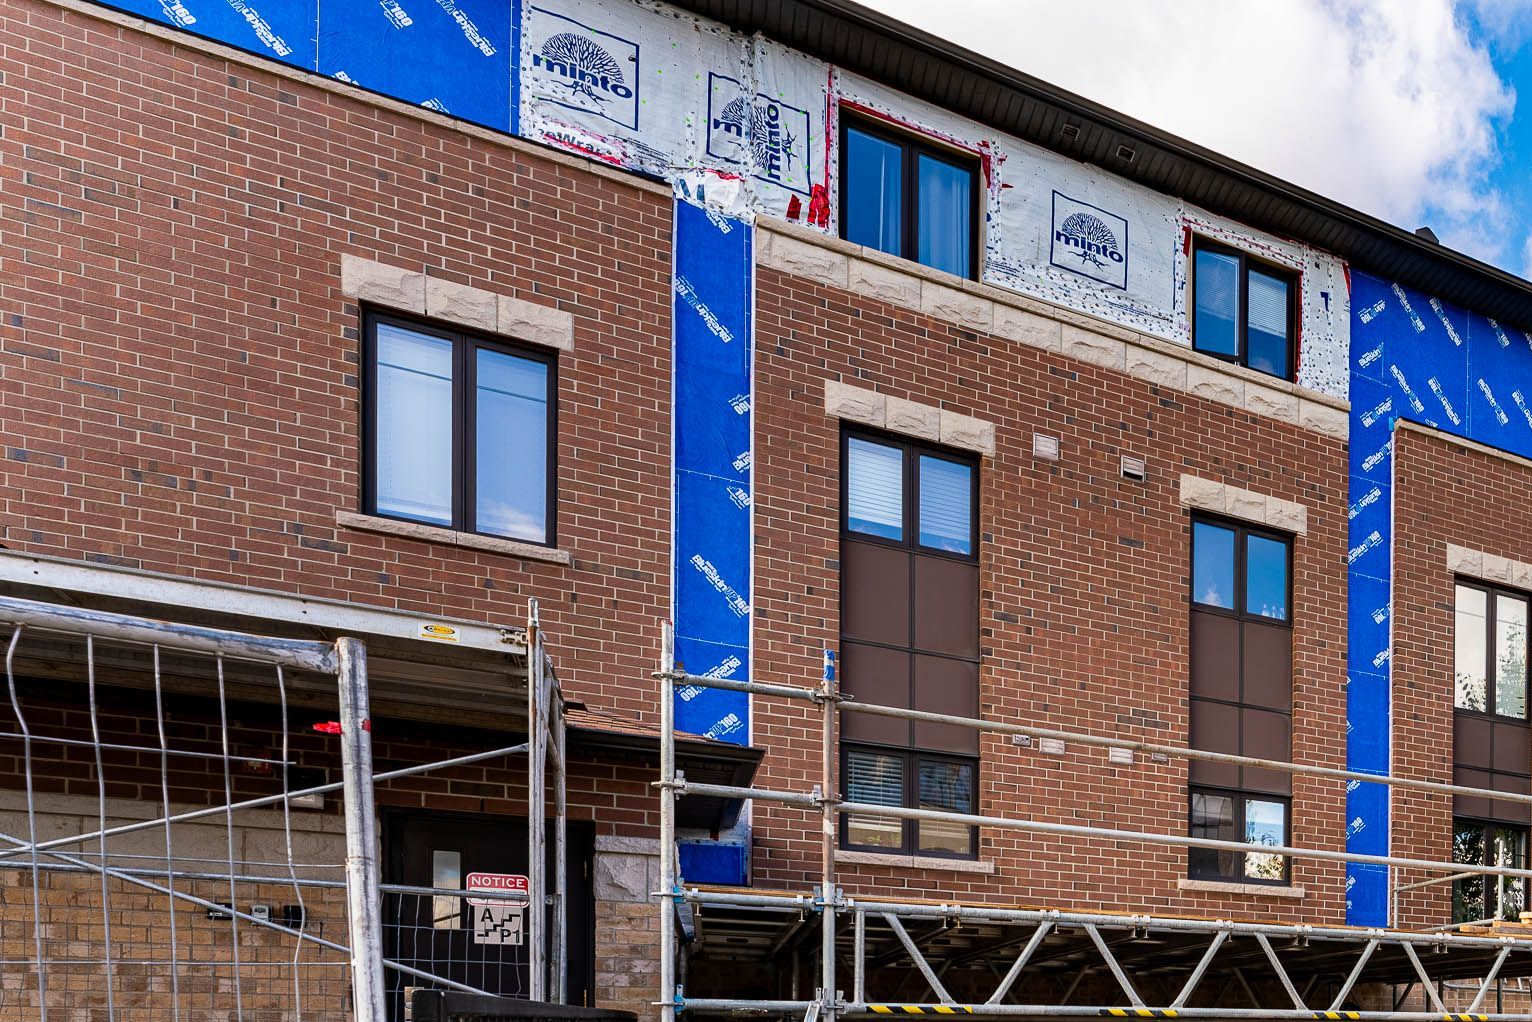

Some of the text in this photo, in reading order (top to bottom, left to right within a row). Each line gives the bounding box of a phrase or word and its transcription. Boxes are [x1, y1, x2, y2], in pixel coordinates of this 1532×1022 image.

[533, 53, 633, 99] minto
[762, 103, 781, 181] minto
[1055, 229, 1124, 263] minto
[471, 876, 526, 889] NOTICE
[480, 908, 494, 922] A
[500, 929, 520, 943] P1
